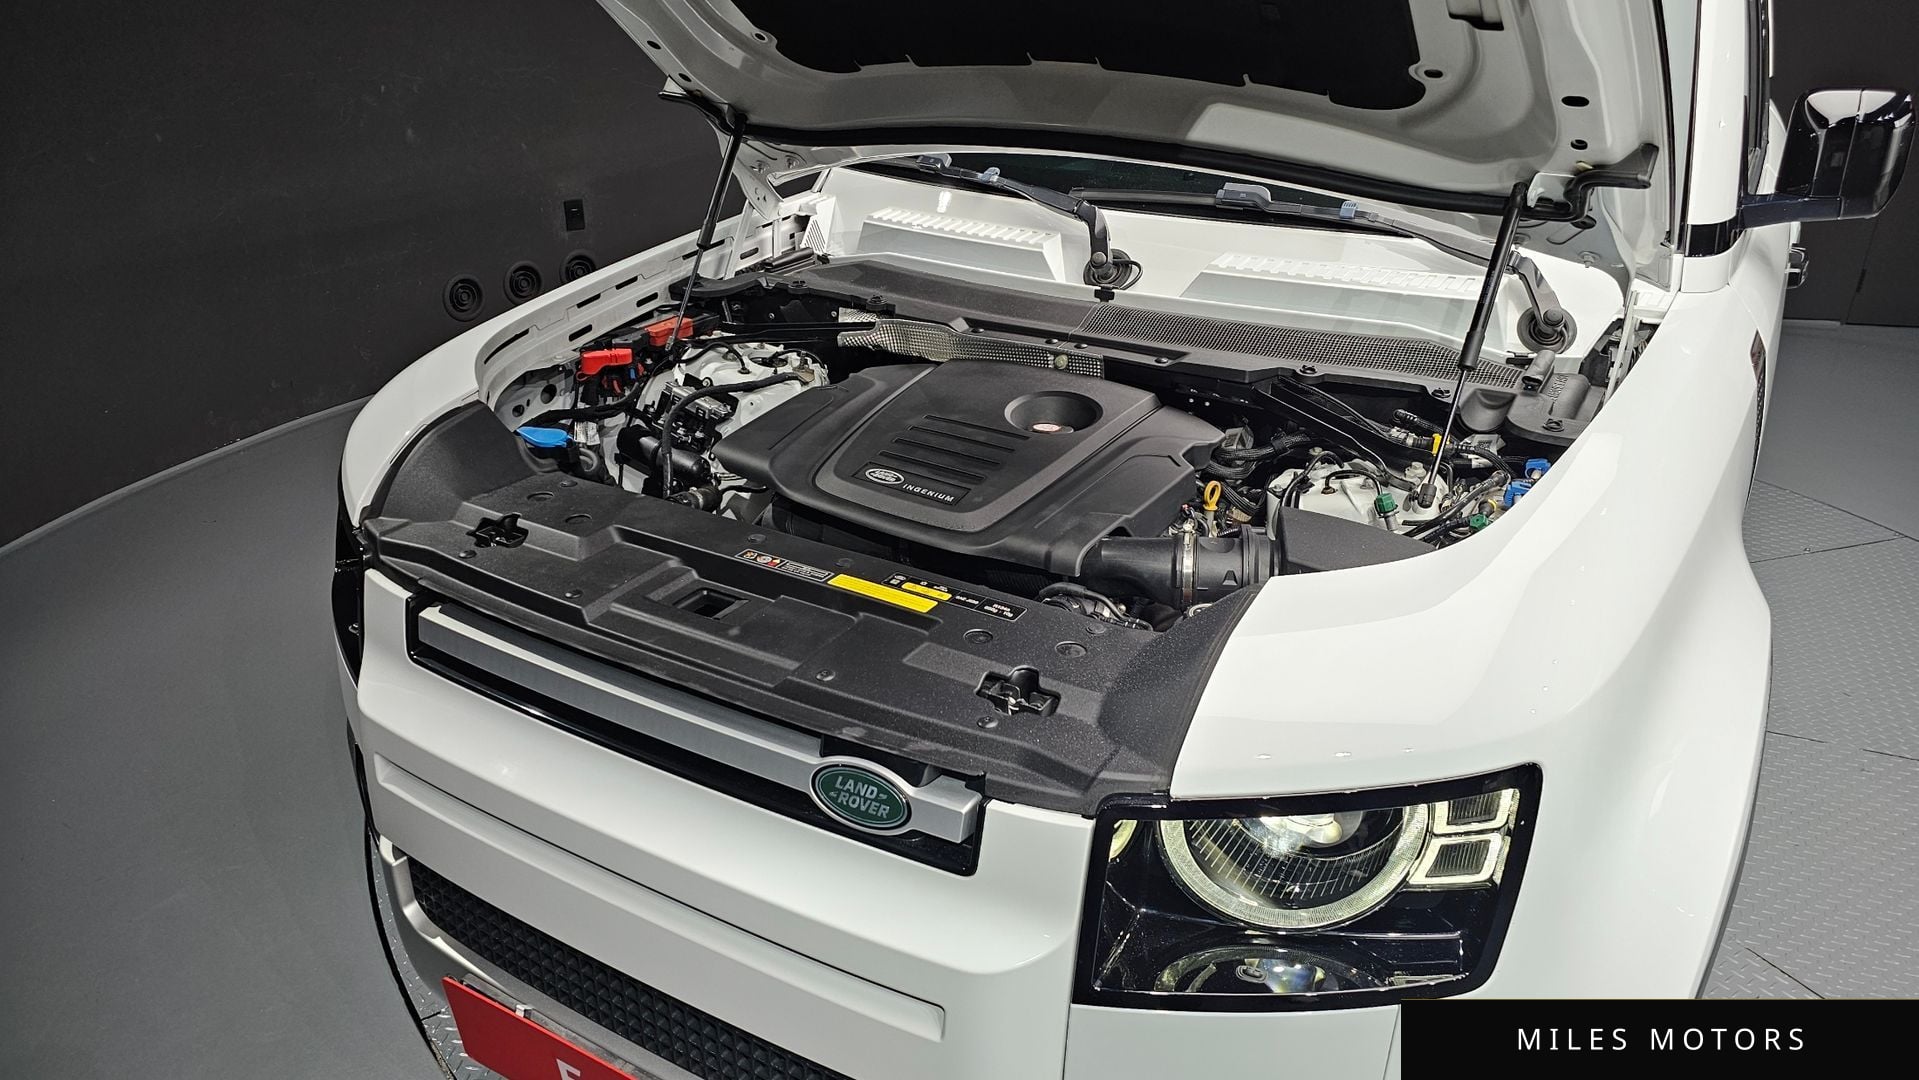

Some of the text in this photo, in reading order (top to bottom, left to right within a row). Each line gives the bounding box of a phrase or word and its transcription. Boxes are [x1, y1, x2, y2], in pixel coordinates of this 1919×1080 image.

[902, 483, 955, 502] INGENIUM
[834, 775, 878, 800] LAND
[837, 791, 890, 818] ROVER
